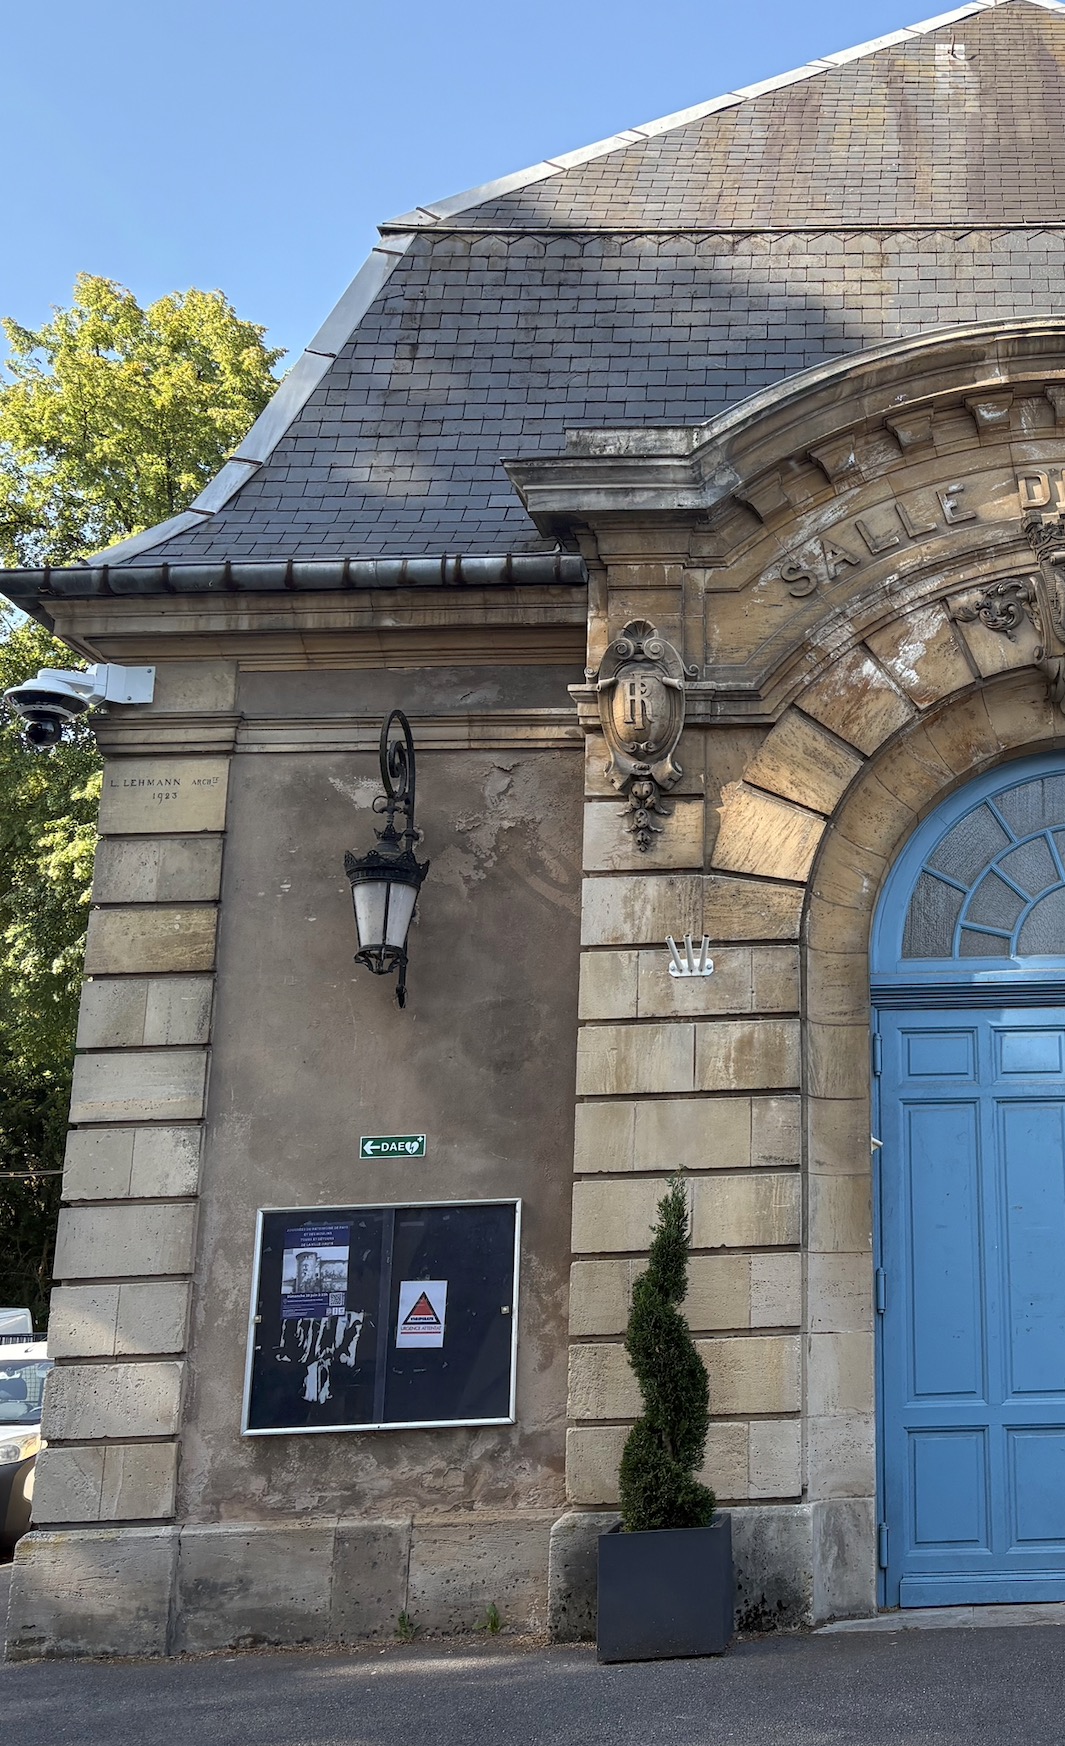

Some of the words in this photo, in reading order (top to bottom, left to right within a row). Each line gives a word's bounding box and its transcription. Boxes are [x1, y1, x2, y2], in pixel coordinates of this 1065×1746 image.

[781, 482, 976, 598] SALLE
[123, 778, 181, 787] LEHMANN
[152, 792, 178, 805] 1923
[381, 1141, 405, 1152] DAE
